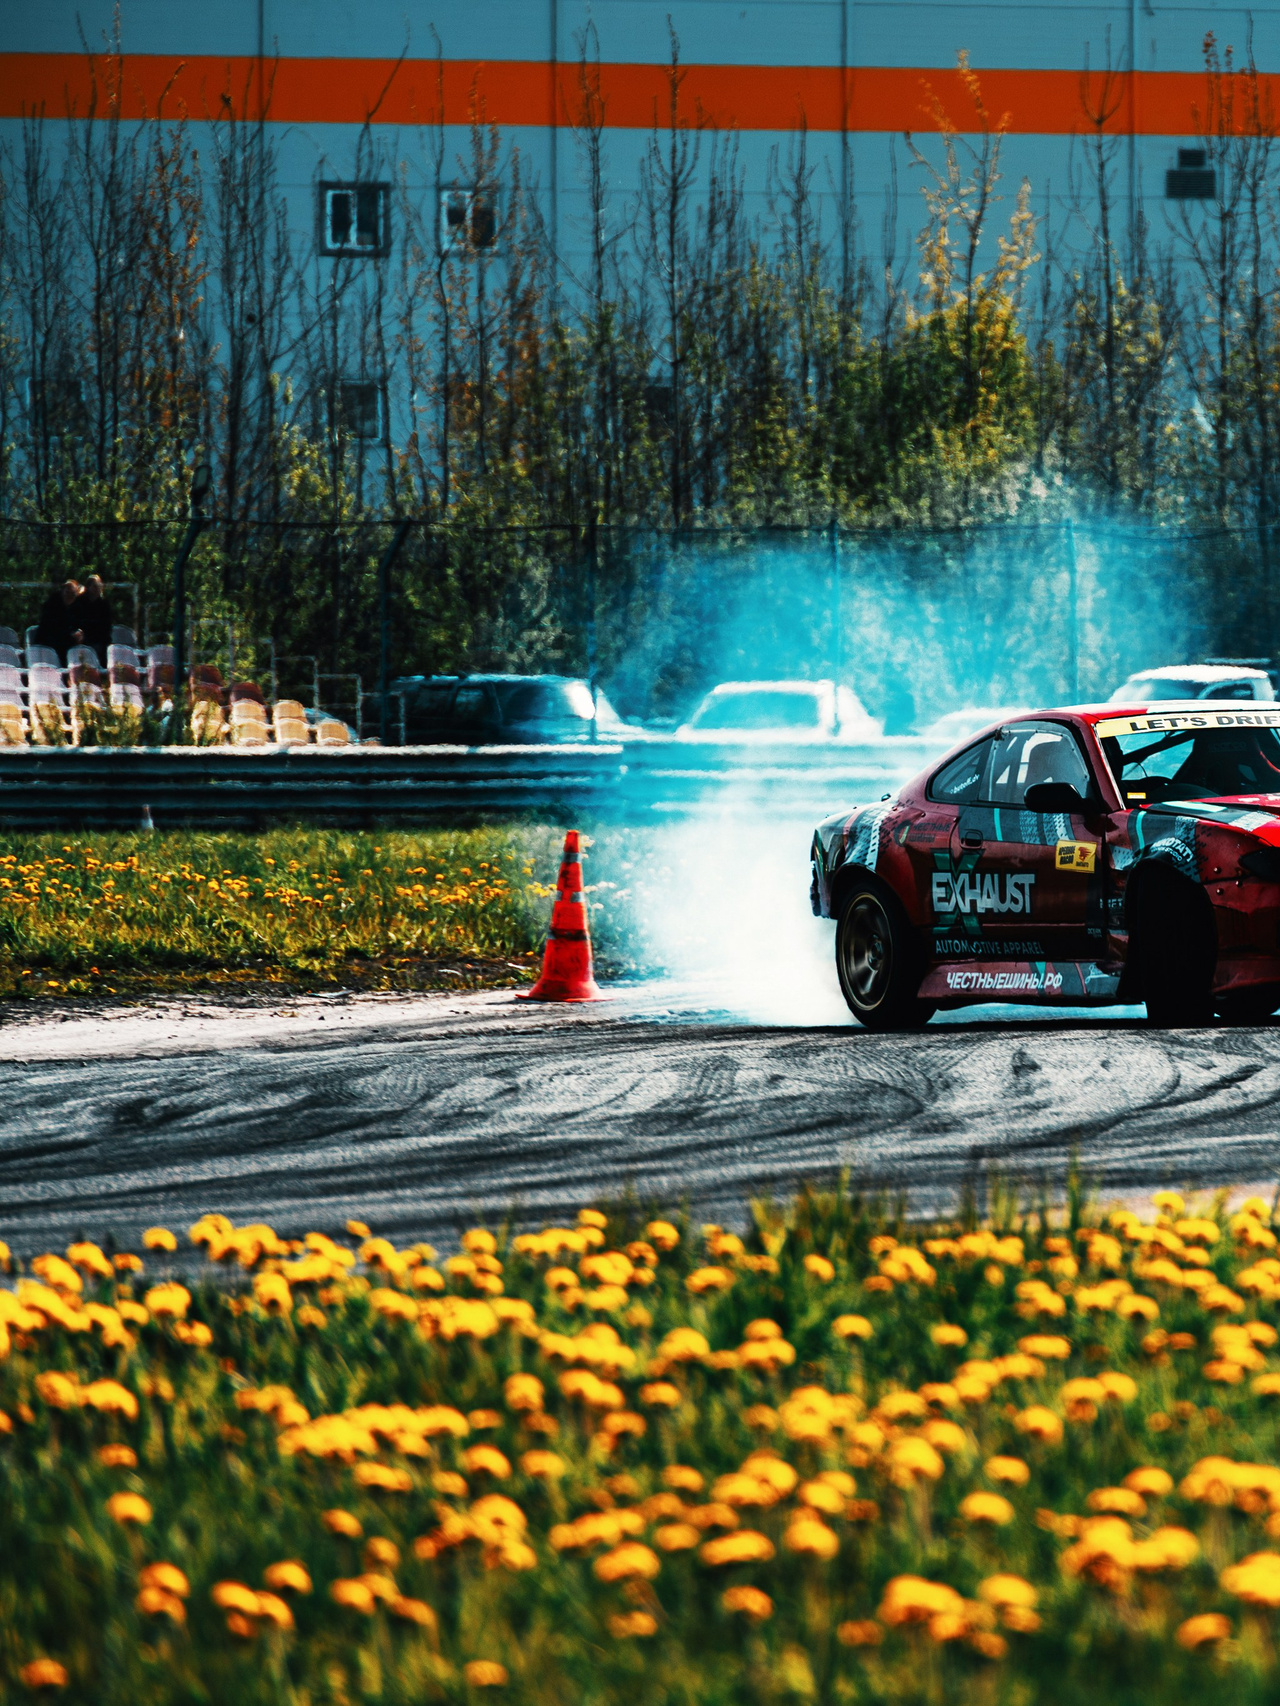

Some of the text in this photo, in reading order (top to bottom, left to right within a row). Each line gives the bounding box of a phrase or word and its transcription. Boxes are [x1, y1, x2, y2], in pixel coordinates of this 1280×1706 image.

[1130, 716, 1208, 732] LET'S
[932, 872, 1036, 913] EXHAUST
[936, 940, 1045, 954] AUTOMOTIVE APPAREL
[946, 971, 1063, 989] ЧЕСТНЫЕШИНЫ.РФ
